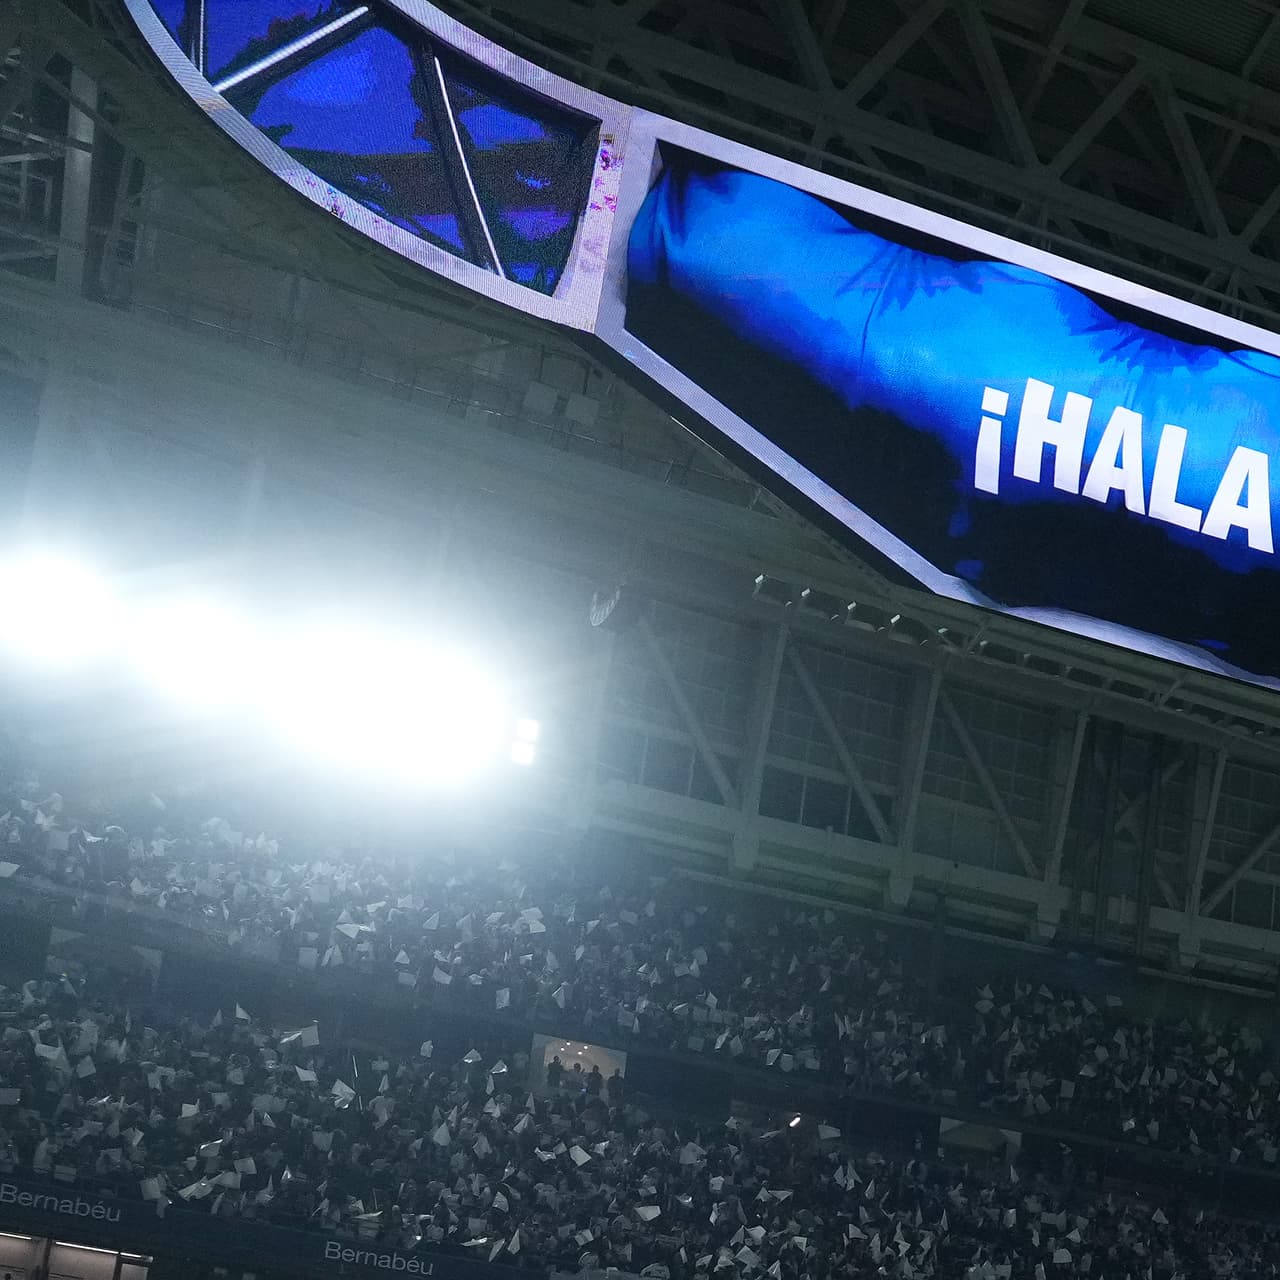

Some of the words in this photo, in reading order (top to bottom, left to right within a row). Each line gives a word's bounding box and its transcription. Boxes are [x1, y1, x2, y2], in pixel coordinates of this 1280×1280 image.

[975, 376, 1273, 554] ¡HALA
[0, 1183, 121, 1222] Bernabéu
[325, 1240, 434, 1277] Bernabéu
